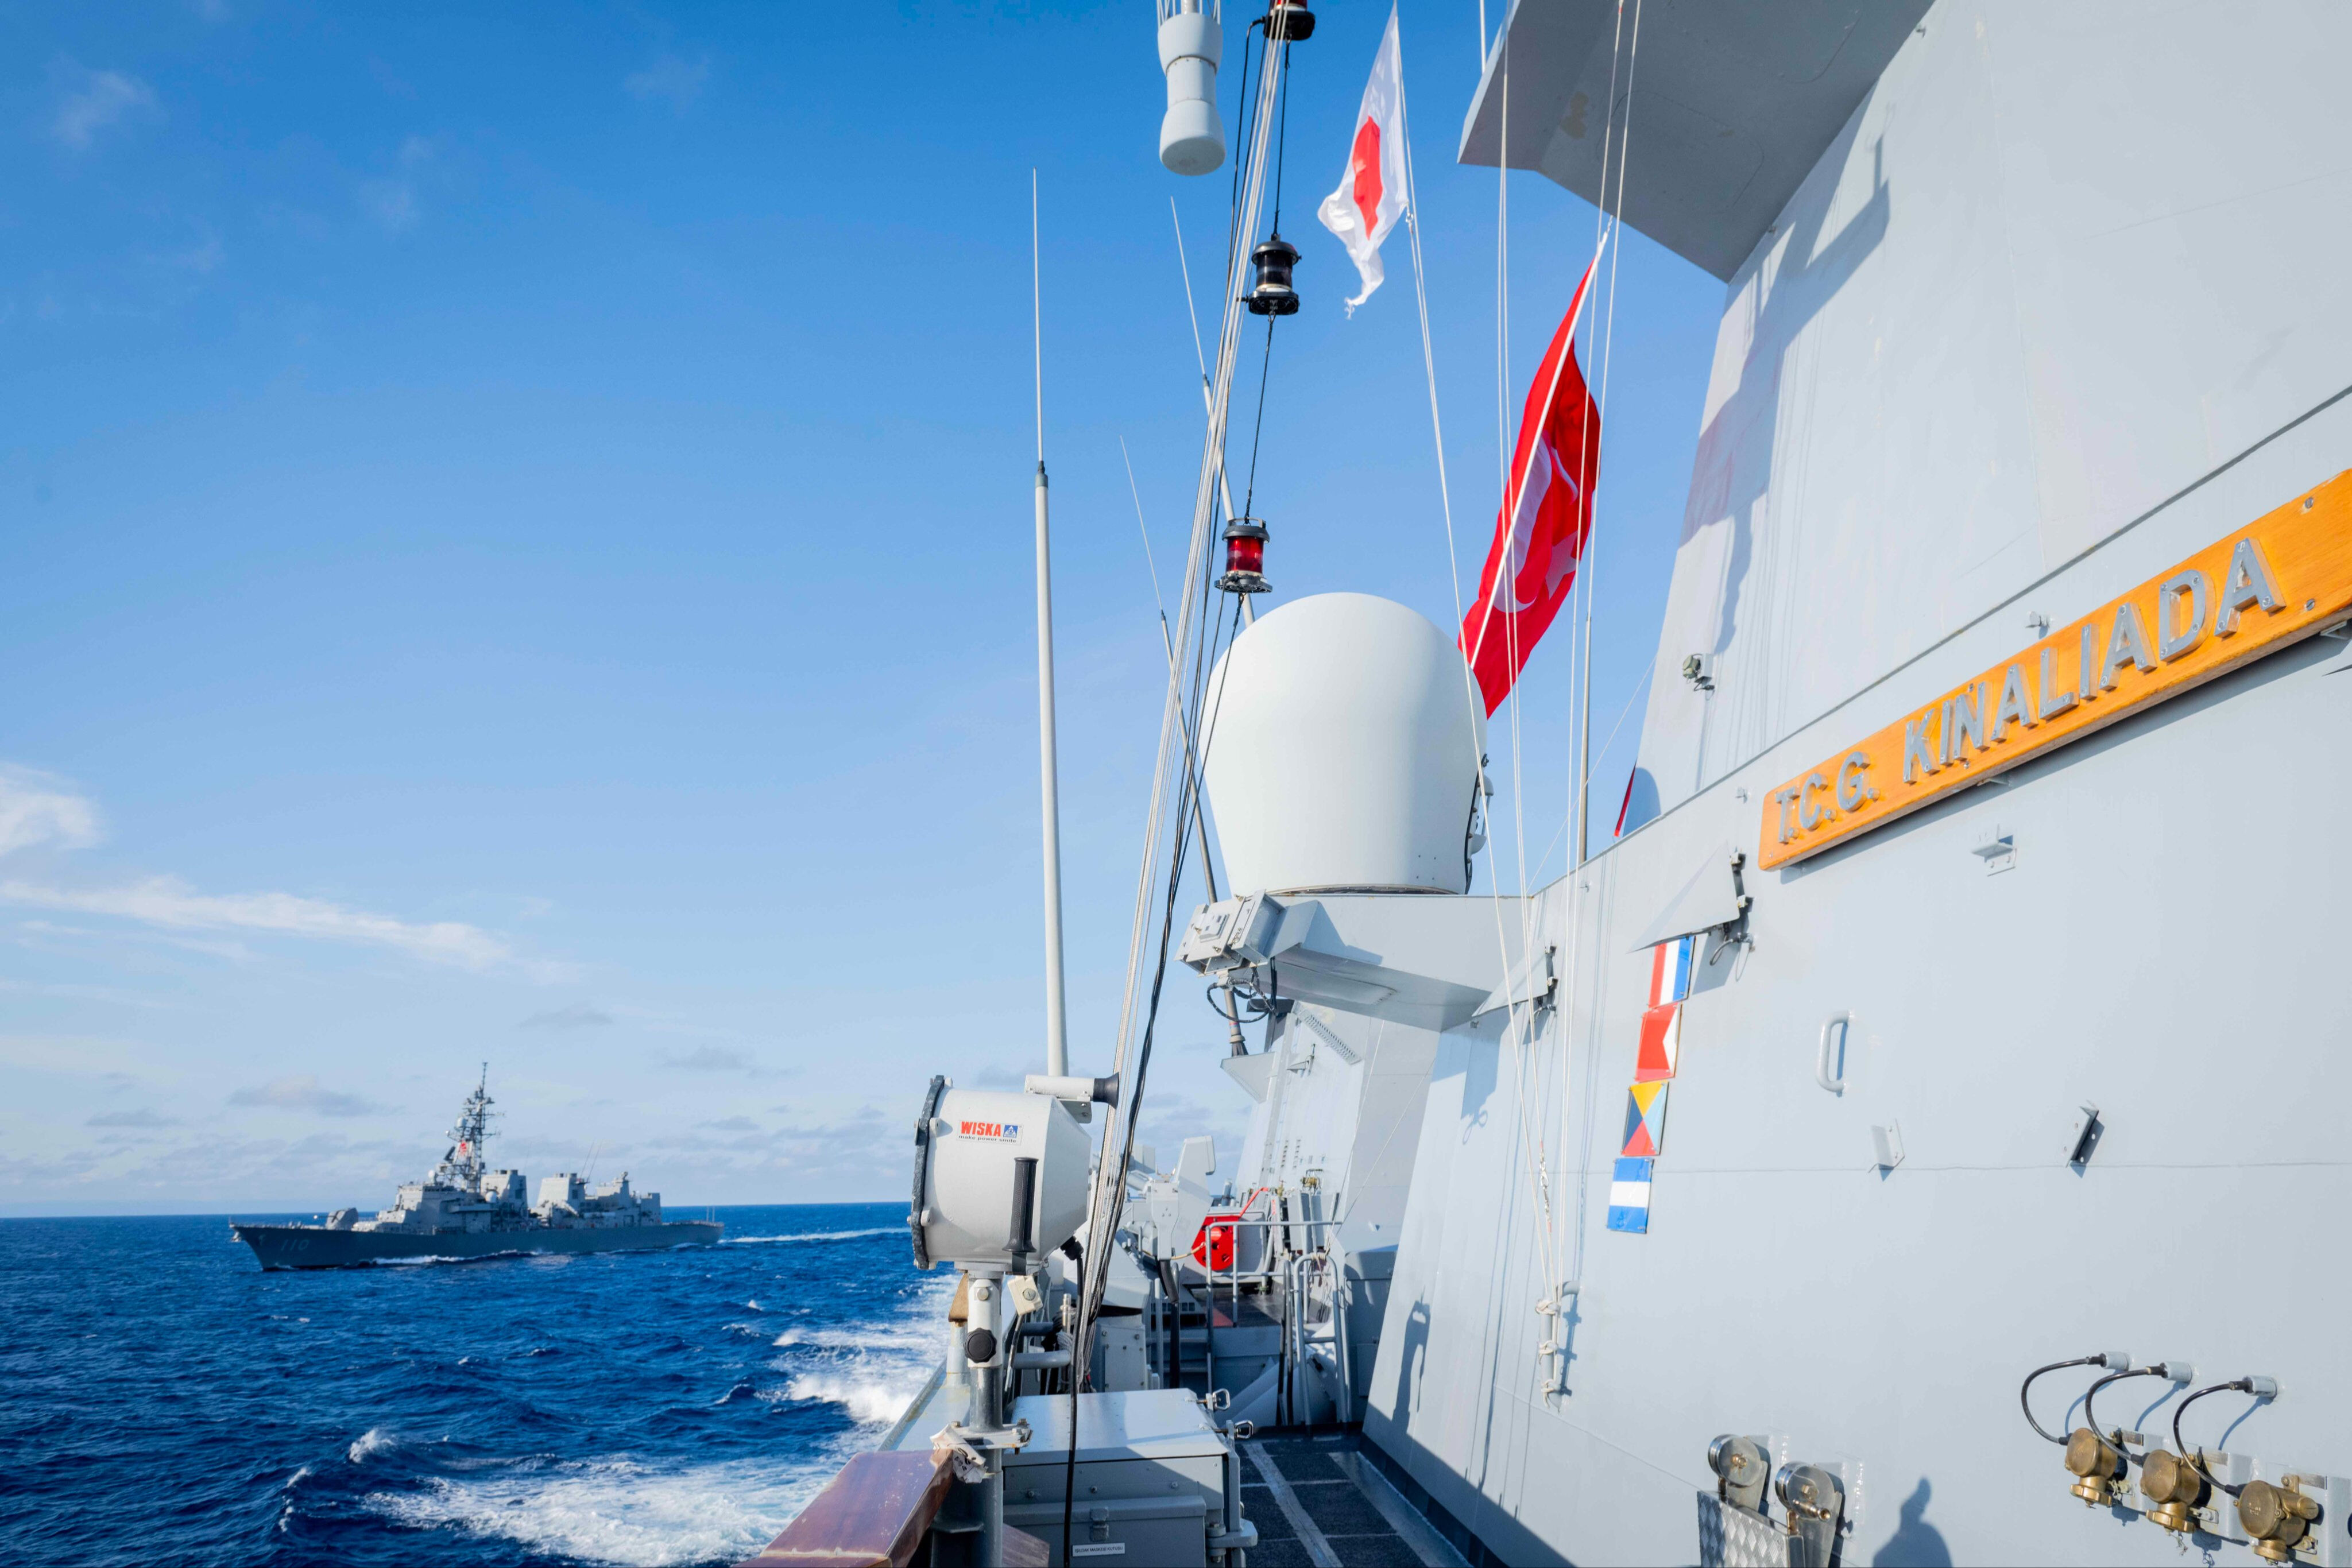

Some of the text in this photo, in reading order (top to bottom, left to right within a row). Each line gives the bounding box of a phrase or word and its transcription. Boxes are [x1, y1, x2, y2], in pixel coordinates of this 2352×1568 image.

[1902, 537, 2287, 785] KINALIADA
[961, 1121, 1001, 1137] WISKA
[280, 1238, 310, 1251] 110
